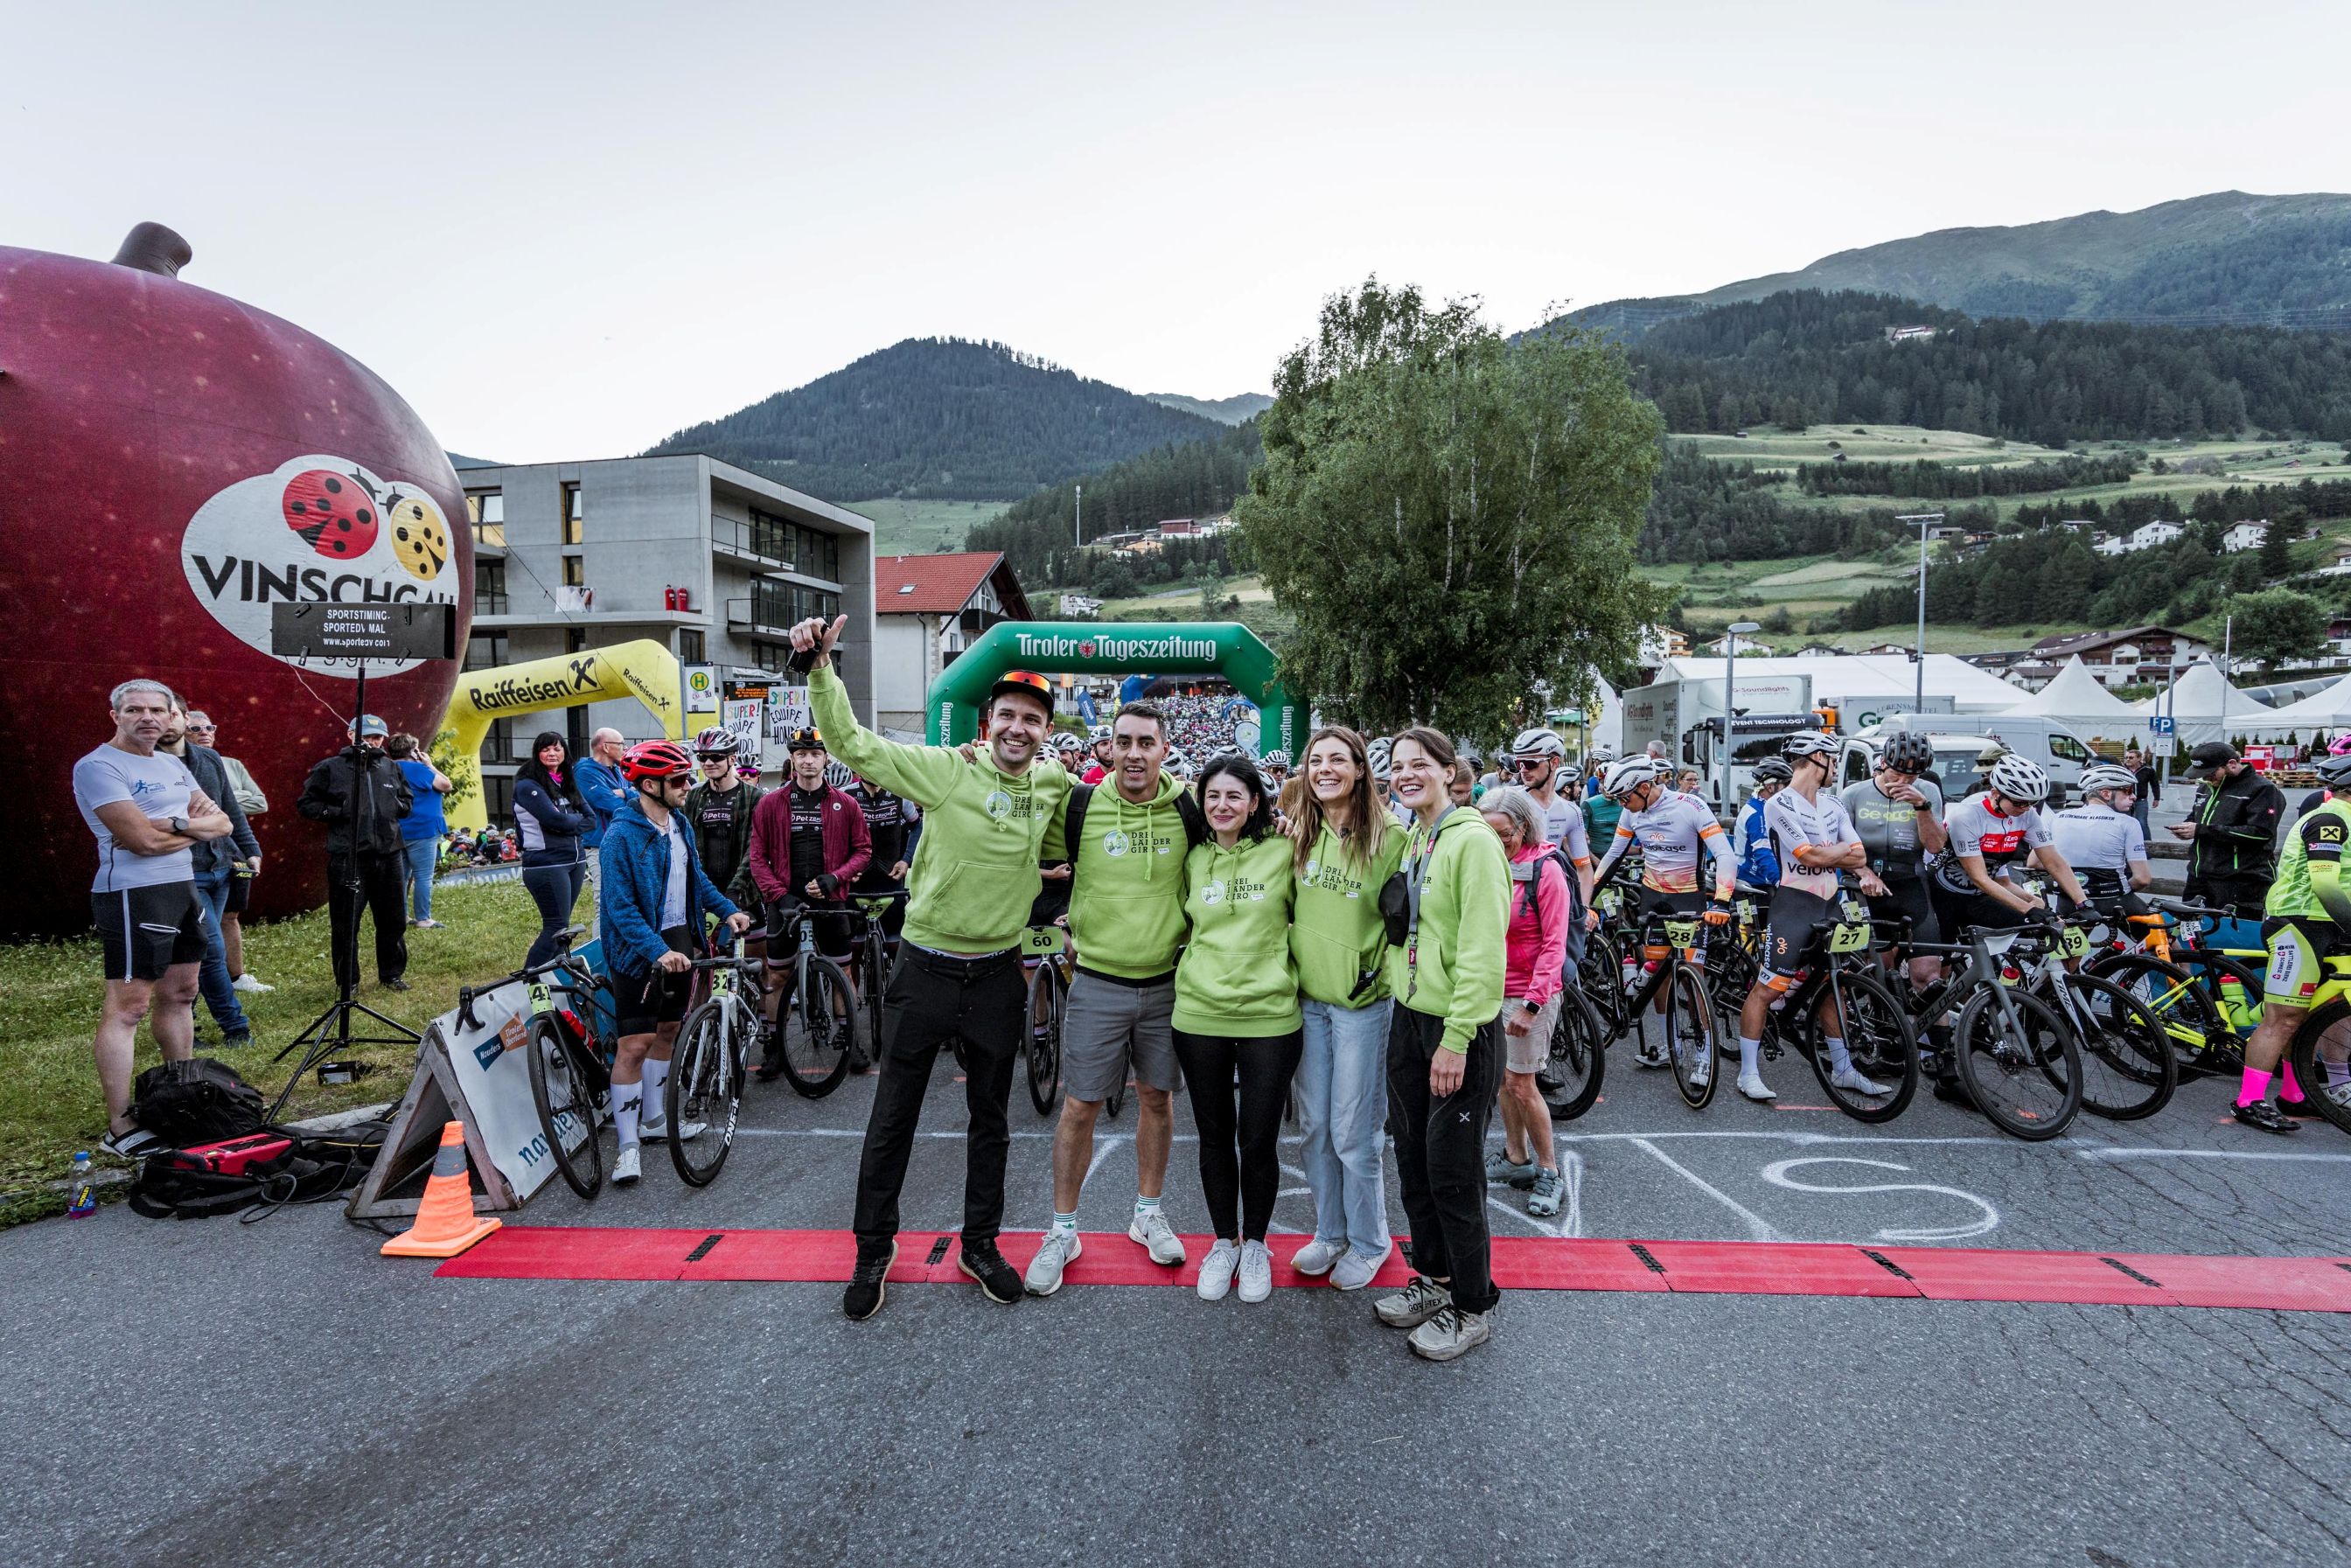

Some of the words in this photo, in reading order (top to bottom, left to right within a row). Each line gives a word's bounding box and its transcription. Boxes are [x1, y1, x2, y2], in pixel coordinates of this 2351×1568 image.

[1015, 633, 1078, 657] Tiroler
[1093, 635, 1217, 662] Tageszeitung
[623, 667, 658, 704] Raiffeisen
[1732, 686, 1790, 696] G-Soundlights
[469, 677, 573, 711] Raiffeisen
[2160, 719, 2172, 732] P
[1325, 866, 1343, 876] DRE
[1322, 881, 1338, 892] GIR
[1032, 936, 1052, 947] 60
[1670, 930, 1691, 943] 28
[1838, 932, 1860, 945] 27
[505, 1023, 524, 1038] Tiroler
[505, 1030, 527, 1048] Oberland
[479, 1041, 502, 1060] Nauders
